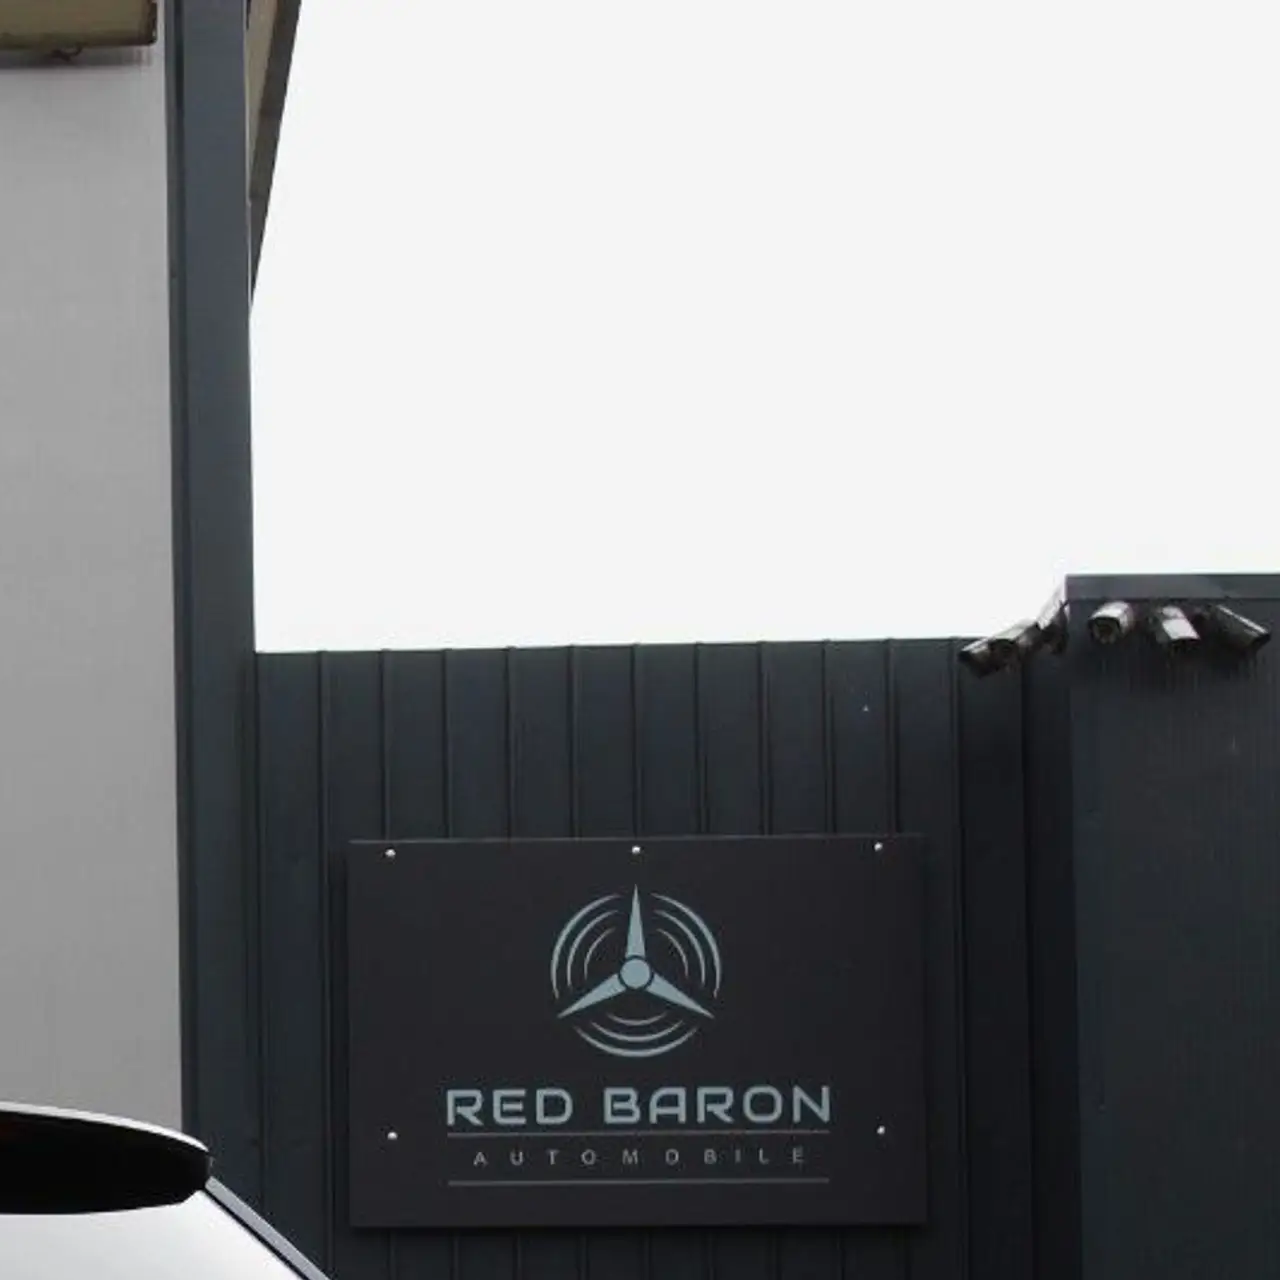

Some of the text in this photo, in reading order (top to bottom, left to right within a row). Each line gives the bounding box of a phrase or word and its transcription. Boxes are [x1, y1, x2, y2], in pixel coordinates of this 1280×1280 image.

[447, 1084, 831, 1126] RED BARON
[472, 1146, 805, 1167] AUTOMOBILE
